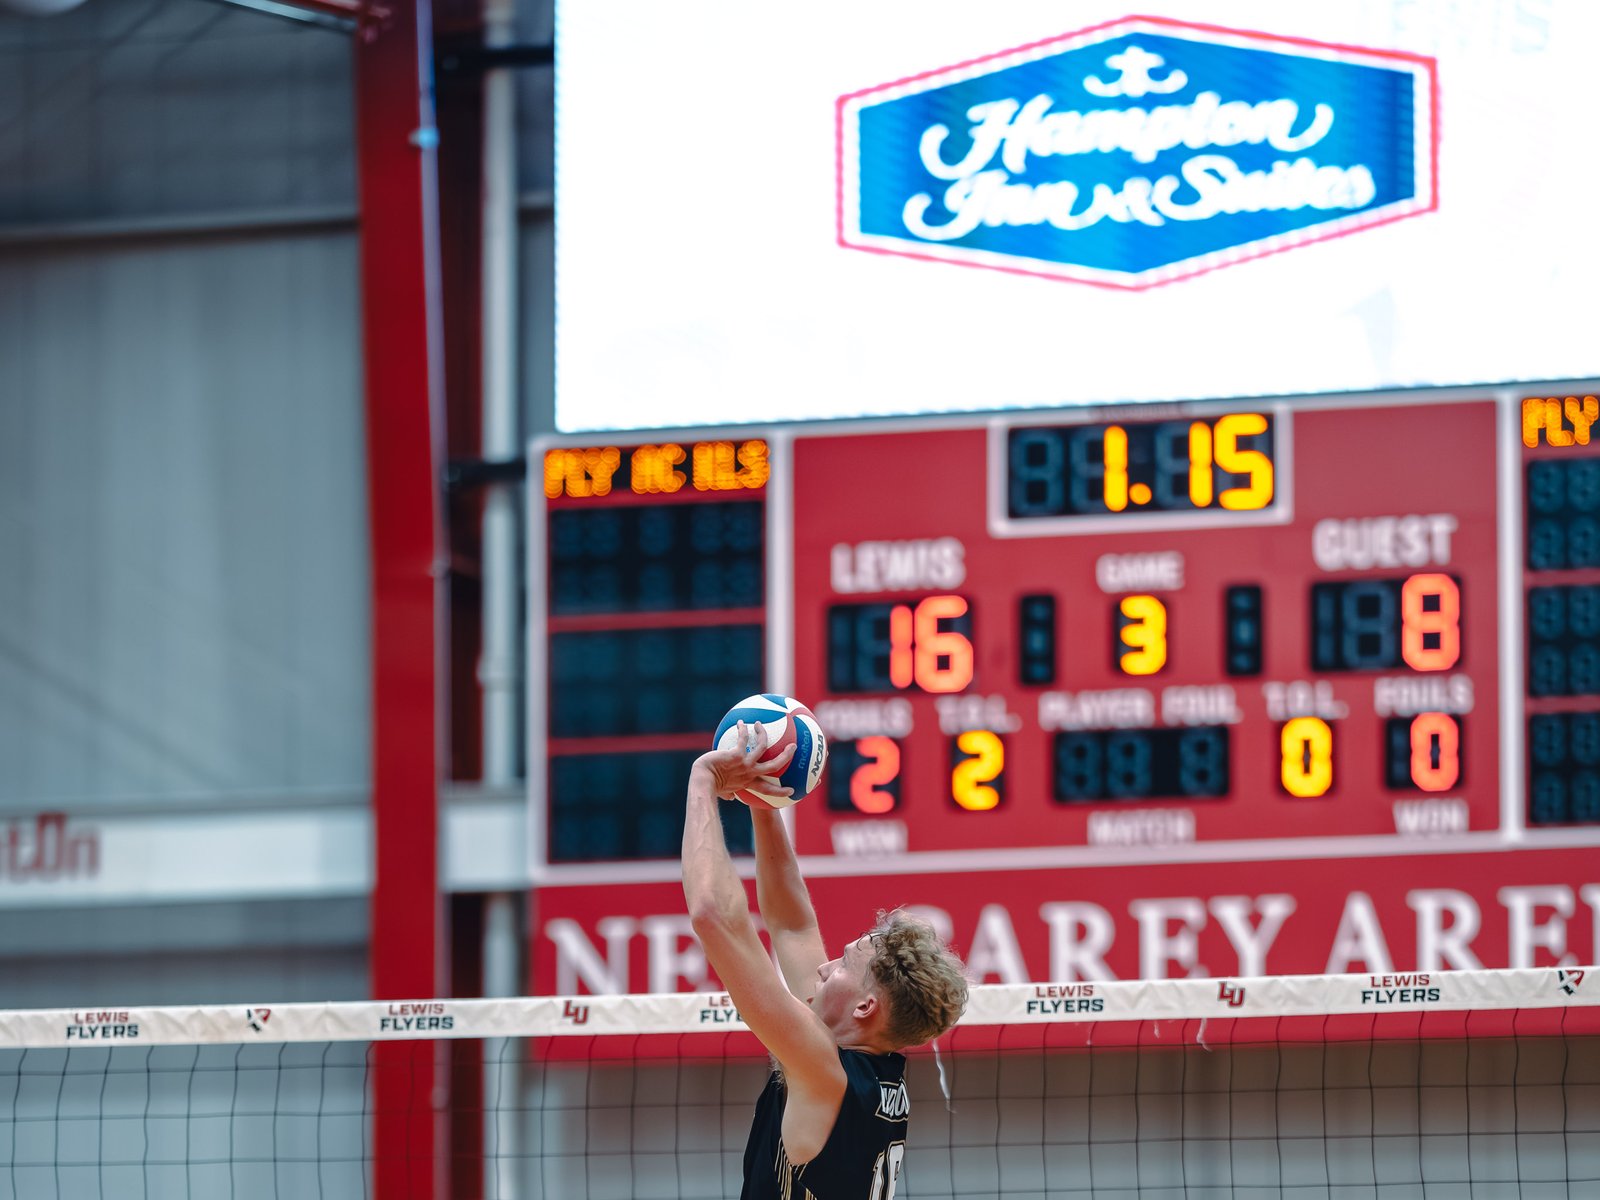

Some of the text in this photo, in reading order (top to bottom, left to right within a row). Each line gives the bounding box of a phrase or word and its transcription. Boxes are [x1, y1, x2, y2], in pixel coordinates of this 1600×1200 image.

[919, 91, 1334, 180] Hampton
[902, 169, 1107, 241] Inn
[1152, 155, 1376, 221] Suites
[1312, 514, 1459, 571] GUEST
[830, 537, 967, 594] LEWIS
[1095, 550, 1184, 594] GAME
[890, 595, 973, 693] 16
[1120, 595, 1167, 675] 3
[1402, 573, 1460, 672] 8
[1038, 687, 1155, 732] PLAYER
[1374, 674, 1474, 717] FOULS
[811, 734, 824, 777] NCAA
[952, 730, 1005, 811] 2
[1281, 716, 1332, 798] 0
[1410, 711, 1459, 792] 0
[850, 735, 900, 814] 2
[1392, 799, 1470, 836] WON
[1325, 885, 1600, 974] ARE
[1035, 984, 1094, 998] LEWIS
[1217, 981, 1246, 1007] LU
[1361, 987, 1440, 1004] FLYERS
[1370, 973, 1430, 988] LEWIS
[75, 1012, 129, 1025] LEWIS
[380, 1015, 454, 1031] FLYERS
[388, 1003, 445, 1016] LEWIS
[562, 1000, 590, 1025] LU
[1027, 998, 1105, 1014] FLYERS
[66, 1024, 139, 1039] FLYERS
